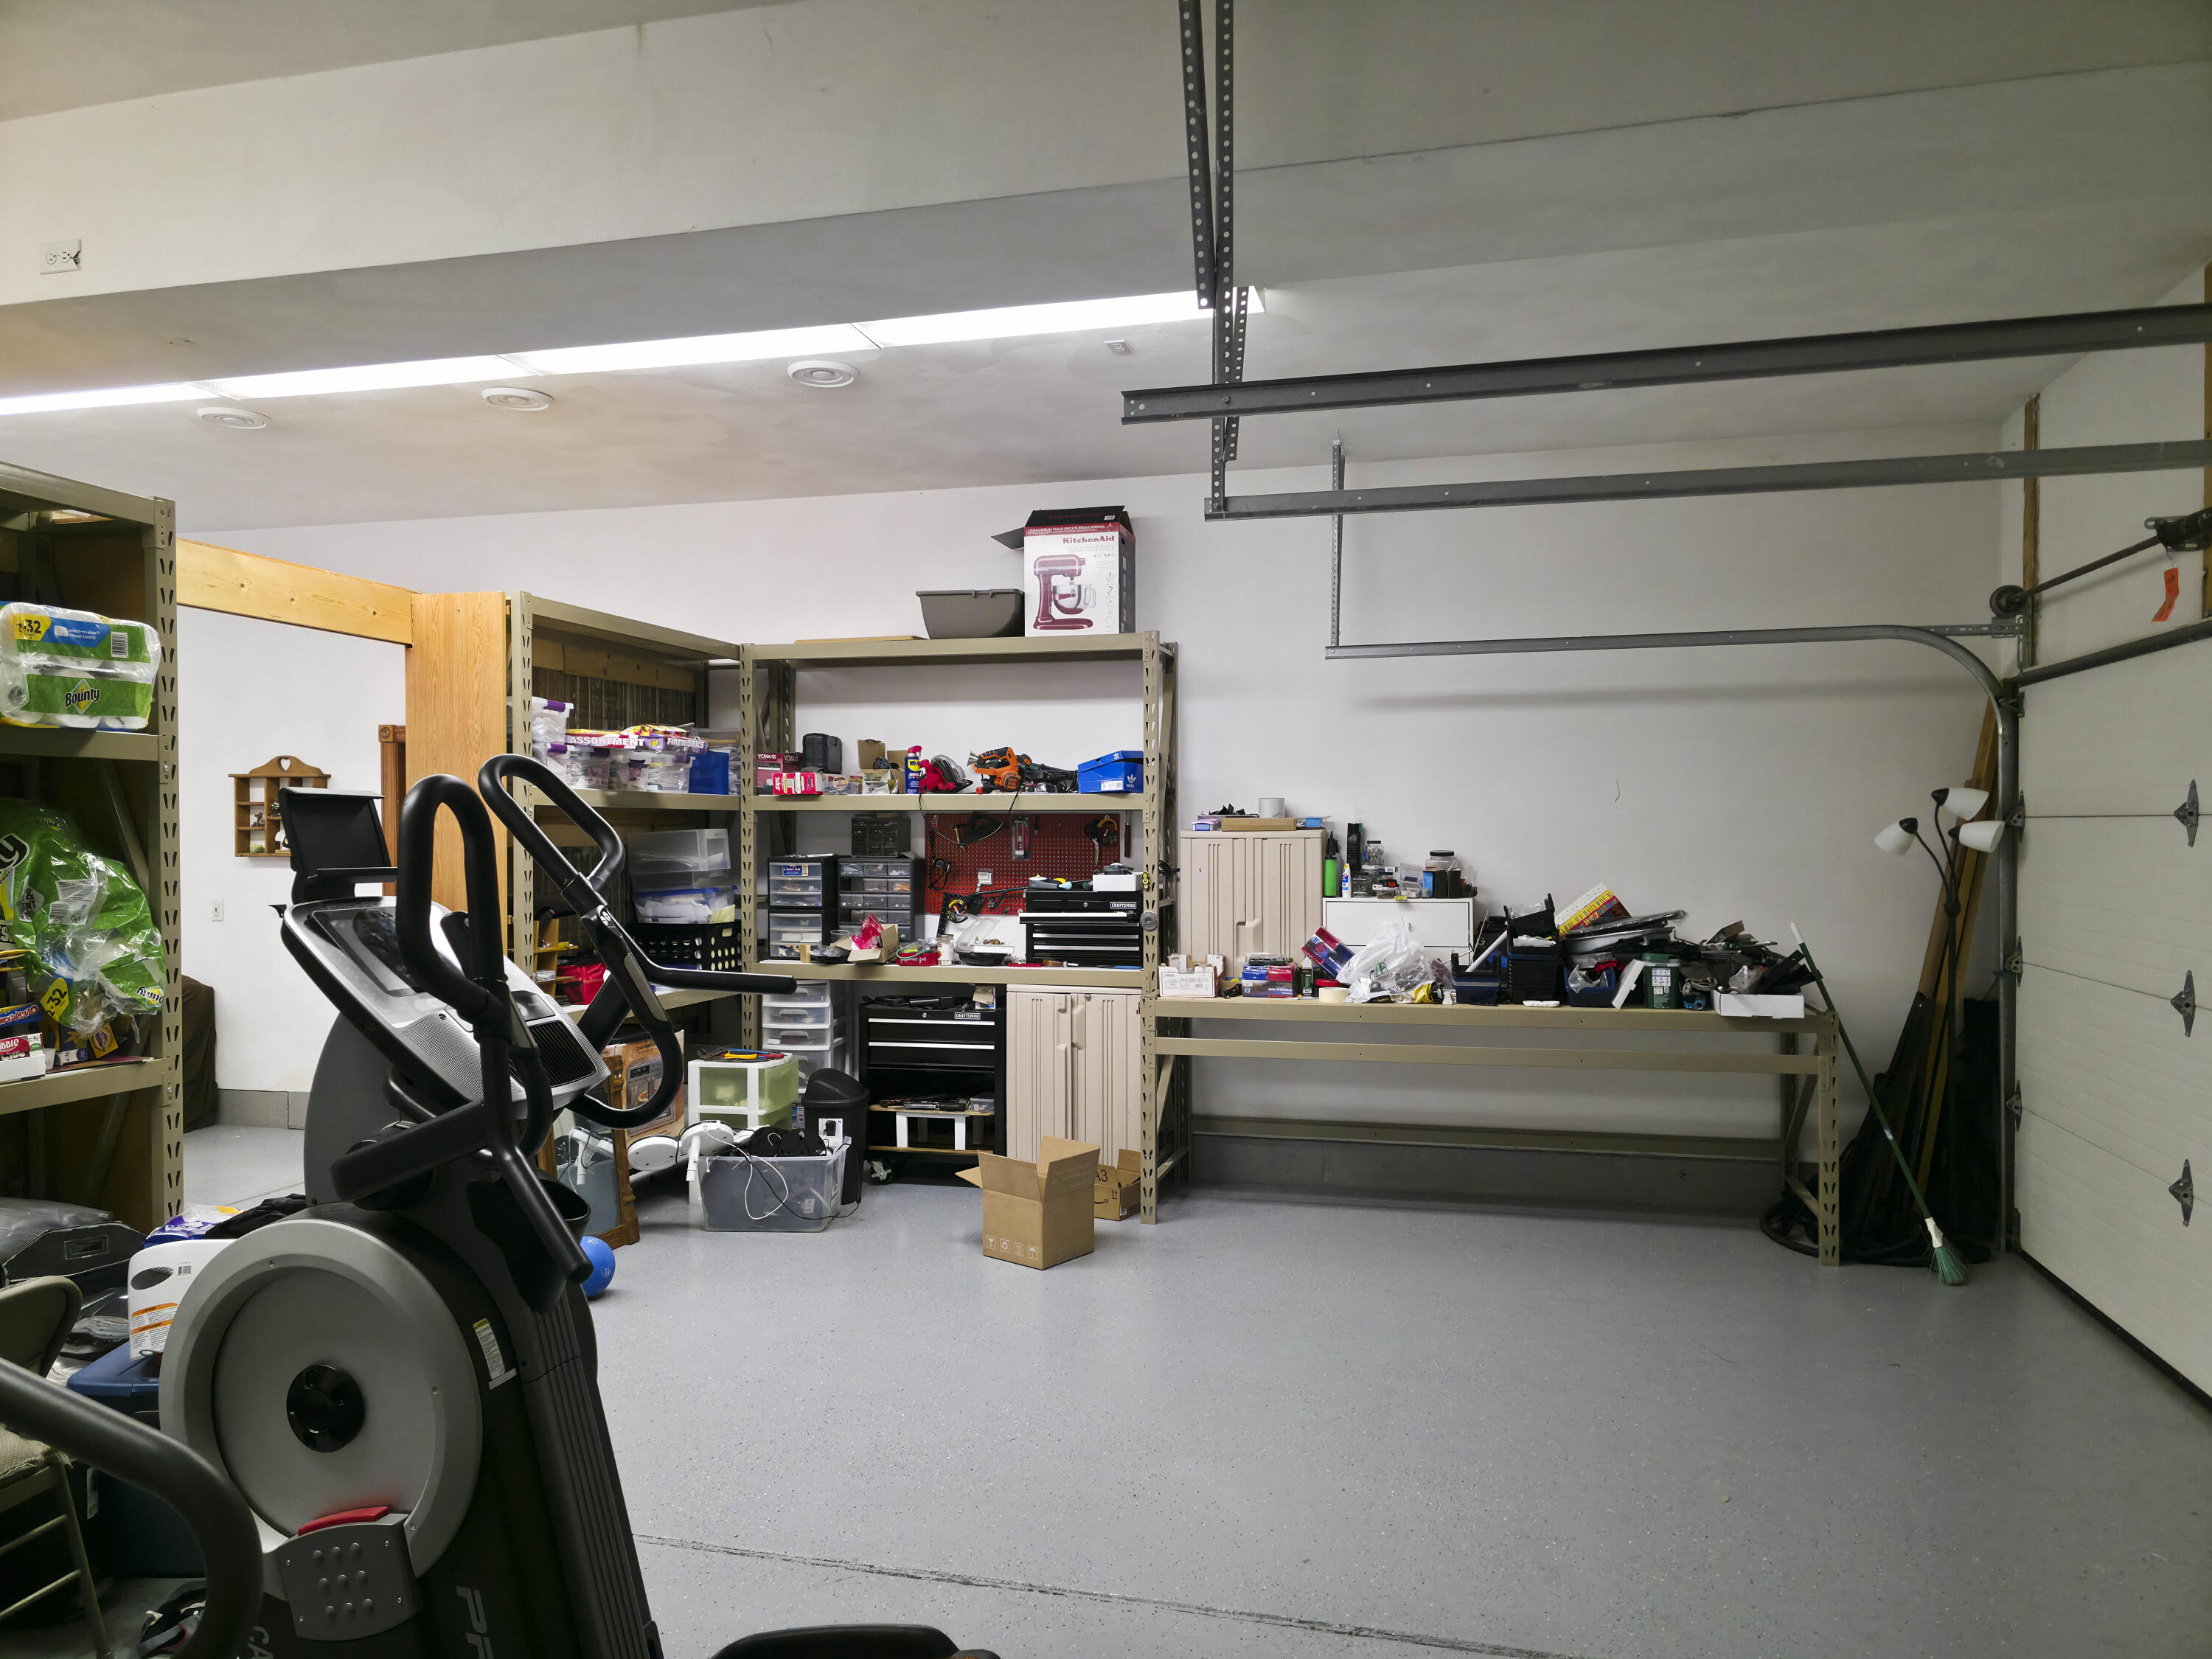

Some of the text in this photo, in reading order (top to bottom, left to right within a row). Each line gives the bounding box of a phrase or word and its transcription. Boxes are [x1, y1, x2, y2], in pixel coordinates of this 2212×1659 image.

[65, 688, 100, 709] Bounty
[570, 737, 644, 747] ASSORTMENT
[667, 739, 704, 748] FIREWORKS
[0, 871, 11, 885] pper
[0, 1038, 19, 1051] BBLE
